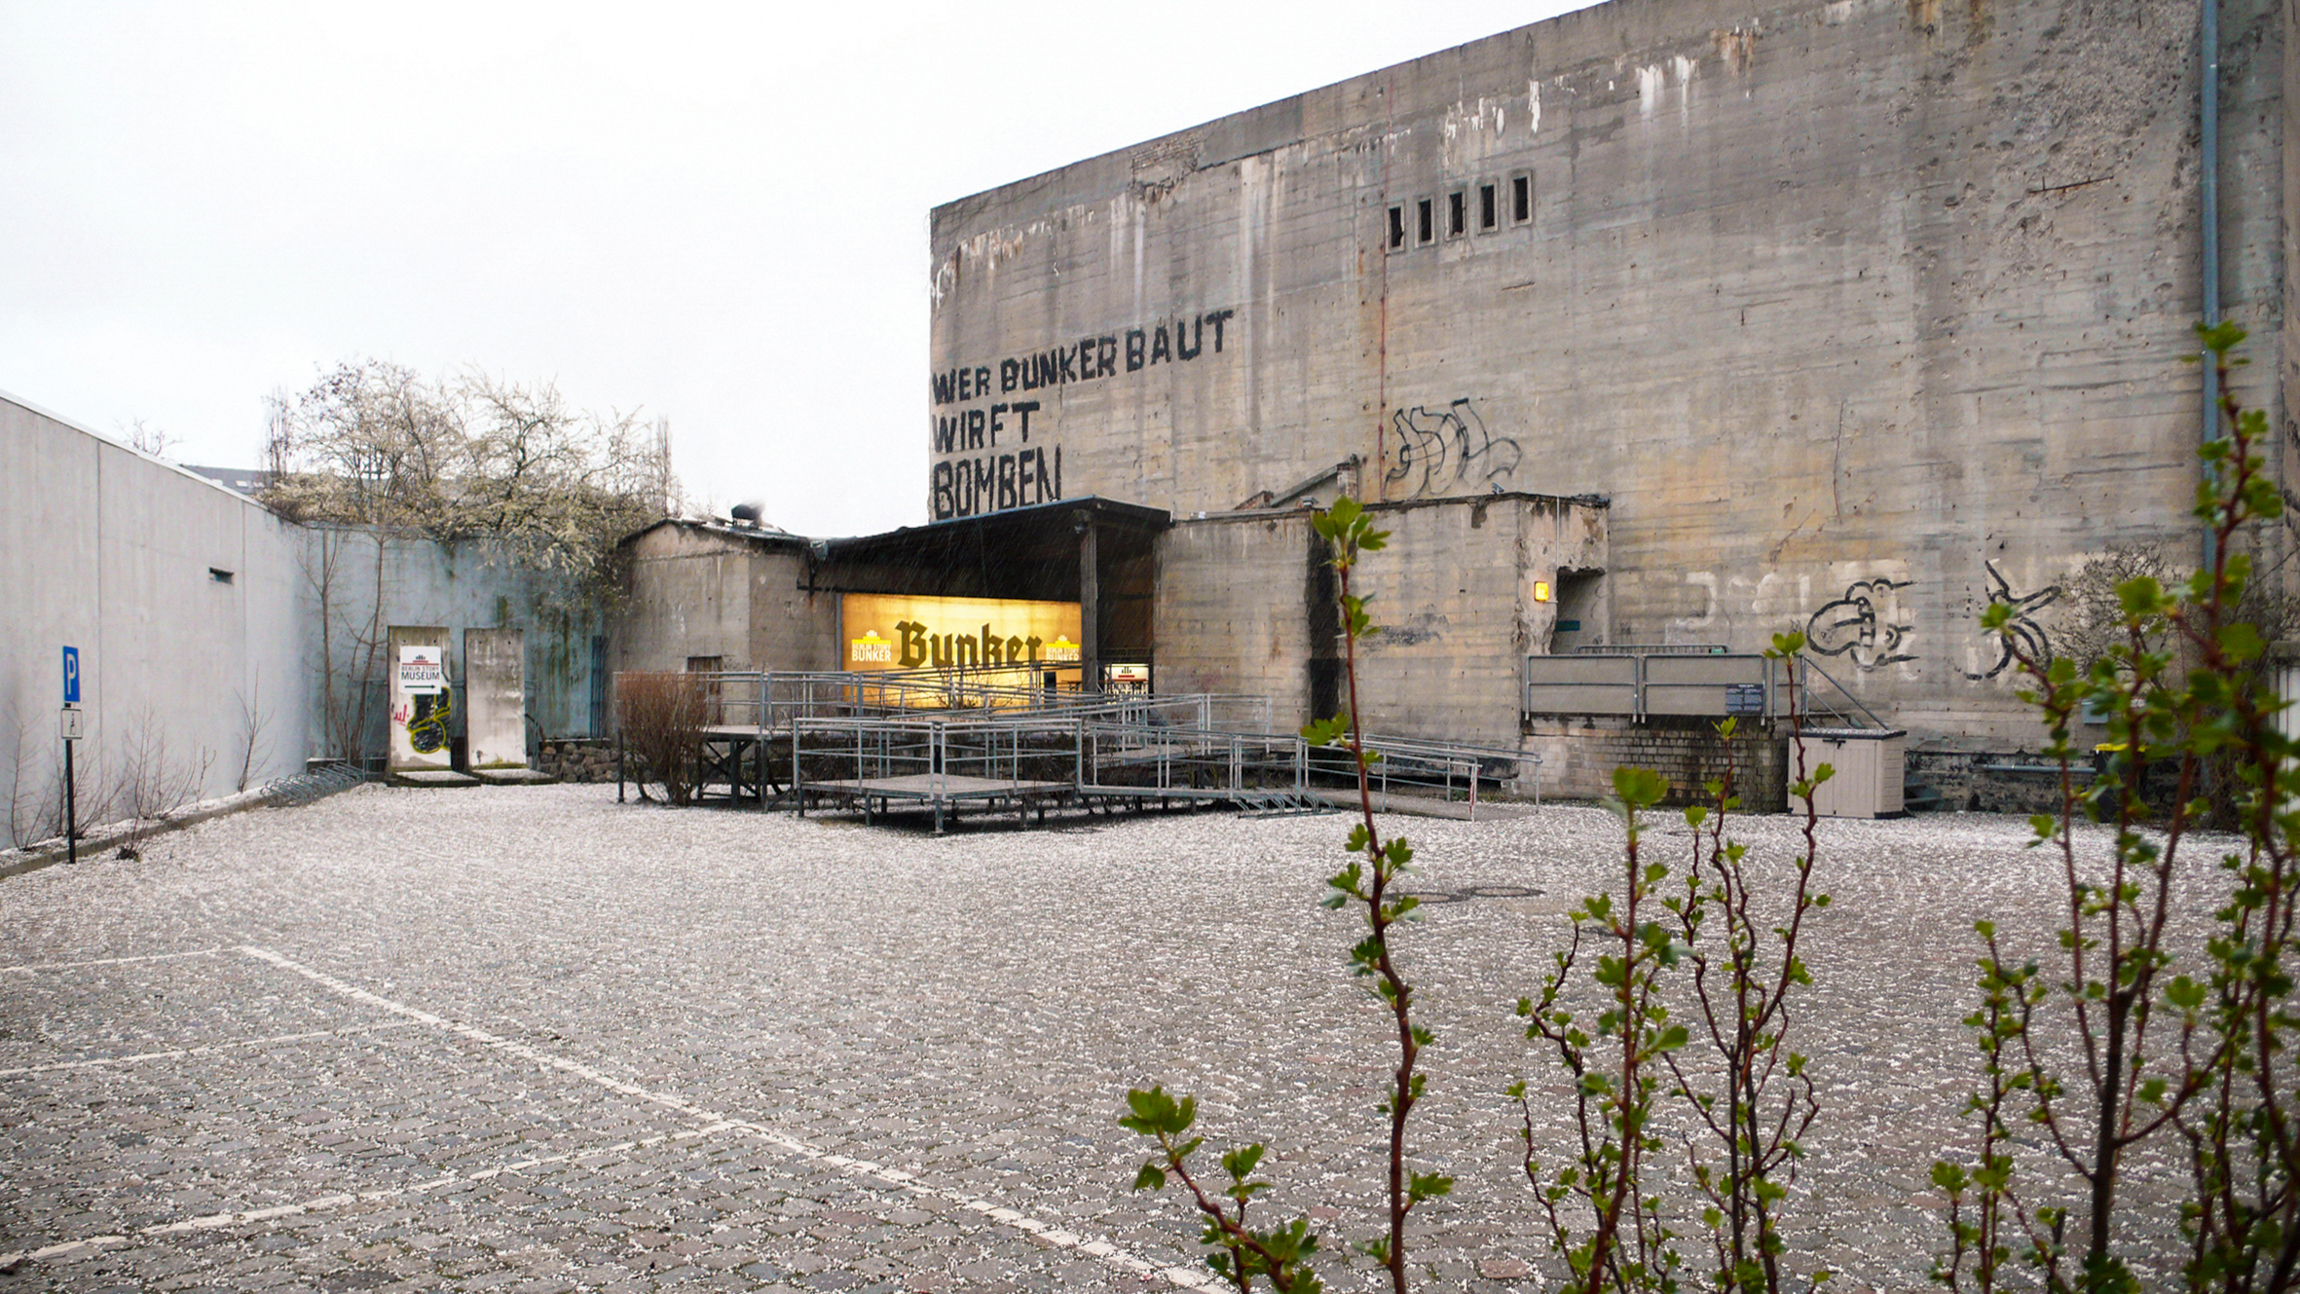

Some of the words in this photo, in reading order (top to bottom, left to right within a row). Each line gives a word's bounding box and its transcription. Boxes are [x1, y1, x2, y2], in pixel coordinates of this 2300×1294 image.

[932, 366, 991, 406] WER
[1000, 336, 1118, 395] BUNKER
[1126, 309, 1234, 373] BAUT
[932, 401, 1041, 453] WIRFT
[933, 443, 1062, 520] BOMBEN
[852, 650, 892, 662] BUNKER
[895, 620, 1043, 669] Bunker
[66, 653, 77, 695] P
[401, 671, 440, 681] MUSEUM
